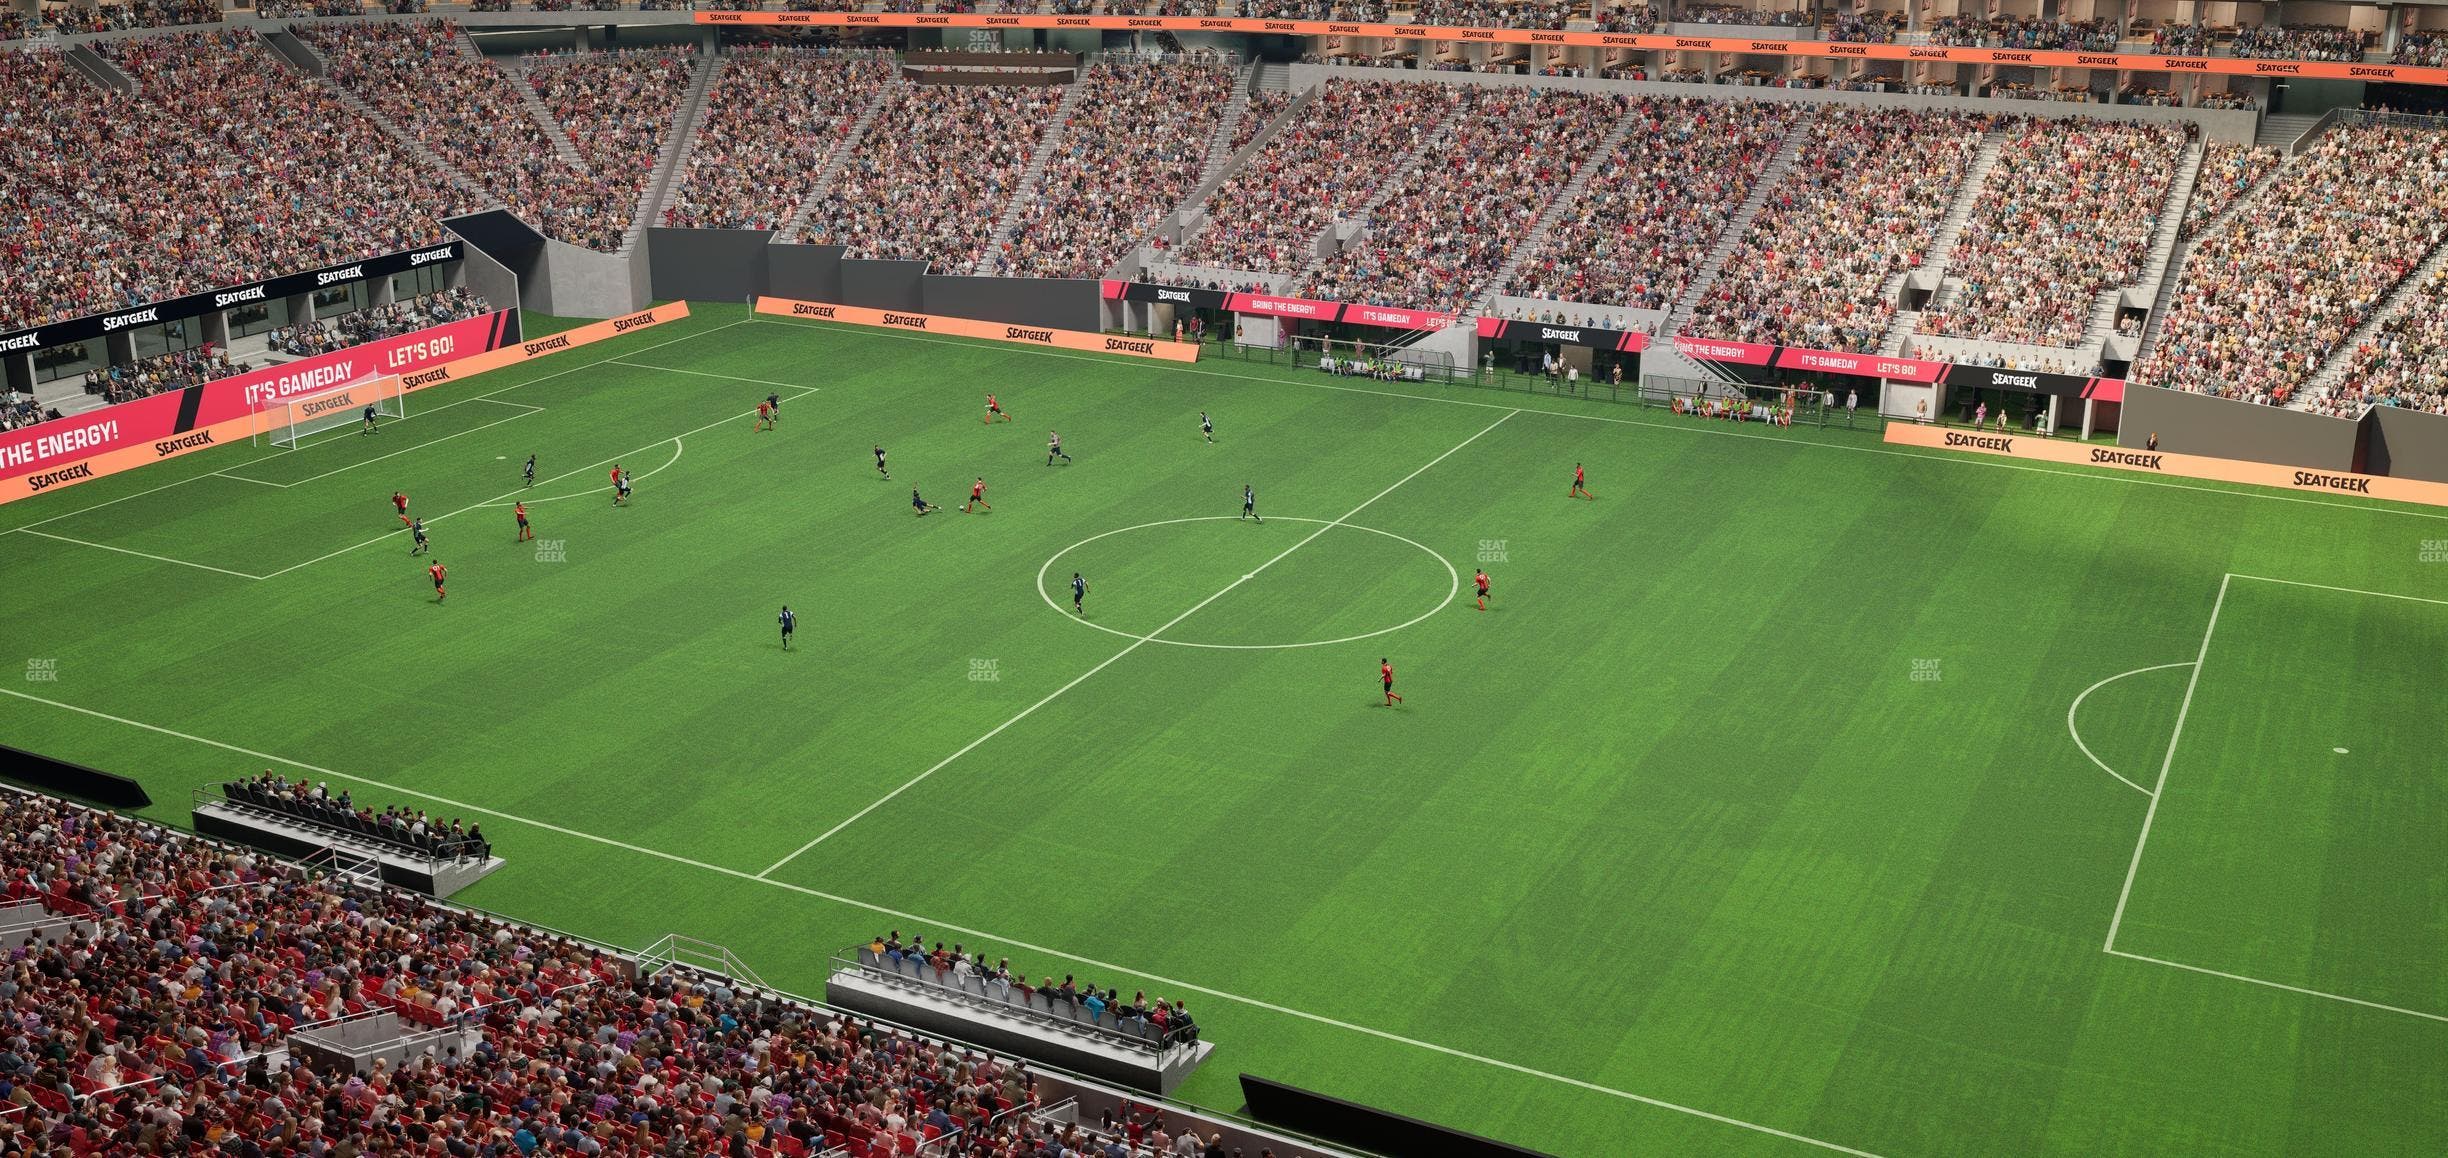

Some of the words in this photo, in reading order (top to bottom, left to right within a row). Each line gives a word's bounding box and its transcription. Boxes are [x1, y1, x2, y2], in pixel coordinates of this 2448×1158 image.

[847, 15, 879, 23] SEATGEEK
[986, 17, 1019, 25] SEATGEEK
[1057, 18, 1090, 26] SEATGEEK
[1128, 19, 1161, 27] SEATGEEK
[1200, 21, 1231, 29] SEATGEEK
[1265, 22, 1295, 31] SEATGEEK
[1329, 25, 1360, 34] SEATGEEK
[1395, 27, 1425, 36] SEATGEEK
[1462, 31, 1494, 40] SEATGEEK
[1532, 33, 1564, 42] SEATGEEK
[1603, 36, 1637, 46] SEATGEEK
[1676, 39, 1711, 49] SEATGEEK
[1752, 43, 1787, 52] SEATGEEK
[1830, 46, 1867, 56] SEATGEEK
[1992, 53, 2032, 63] SEATGEEK
[2078, 56, 2118, 66] SEATGEEK
[2165, 60, 2207, 70] SEATGEEK
[2256, 63, 2300, 74] SEATGEEK
[2350, 67, 2395, 78] SEATGEEK
[411, 246, 452, 265] SEATGEEK
[318, 265, 363, 286] SEATGEEK
[216, 285, 265, 307] SEATGEEK
[1158, 289, 1190, 302] SEATGEEK
[793, 304, 835, 318] SEATGEEK
[1274, 302, 1286, 312] THE
[103, 308, 158, 331] SEATGEEK
[614, 312, 655, 333] SEATGEEK
[883, 313, 927, 329] SEATGEEK
[1378, 313, 1410, 324] GAMEDAY
[1006, 327, 1053, 343] SEATGEEK
[1542, 328, 1579, 342] SEATGEEK
[388, 342, 428, 368] LET'S
[430, 336, 454, 357] GO!
[525, 335, 570, 357] SEATGEEK
[1105, 338, 1154, 354] SEATGEEK
[1710, 346, 1744, 358] ENERGY!
[1802, 355, 1816, 365] IT'S
[1819, 358, 1858, 370] GAMEDAY
[1878, 362, 1900, 374] LET'S
[245, 380, 276, 405] IT'S
[279, 361, 353, 396] GAMEDAY
[402, 367, 450, 390] SEATGEEK
[1992, 373, 2037, 389] SEATGEEK
[302, 393, 353, 417] SEATGEEK
[36, 420, 119, 460] ENERGY!
[155, 430, 214, 457] SEATGEEK
[1945, 432, 2012, 453] SEATGEEK
[2091, 448, 2162, 469] SEATGEEK
[28, 462, 93, 491] SEATGEEK
[2294, 470, 2370, 494] SEATGEEK
